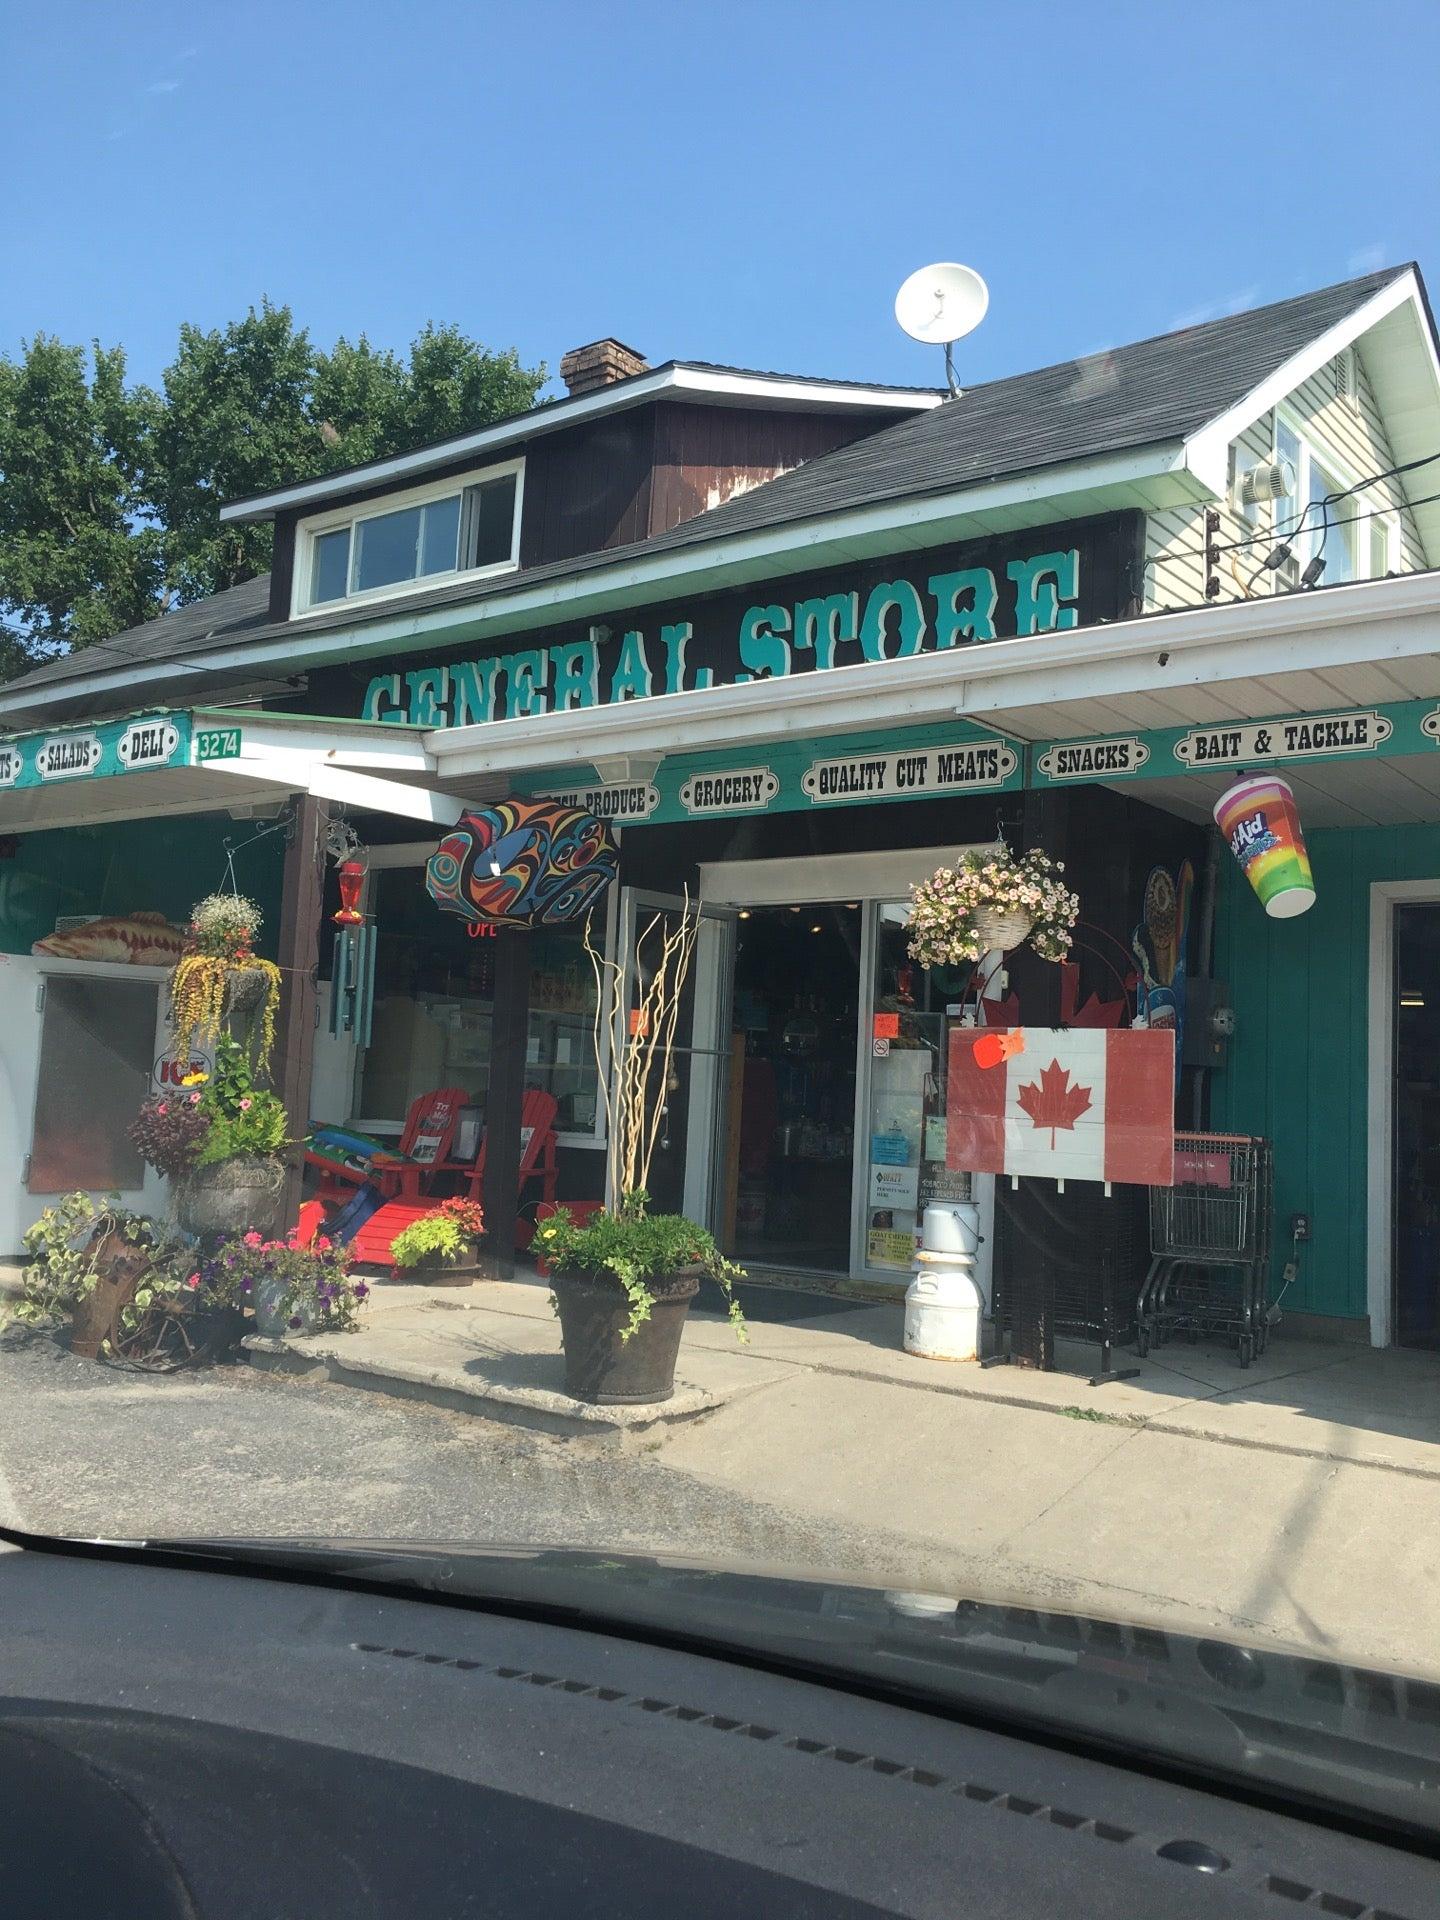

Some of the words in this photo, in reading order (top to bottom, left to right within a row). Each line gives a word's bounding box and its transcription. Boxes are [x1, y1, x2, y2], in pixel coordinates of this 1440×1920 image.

[361, 622, 713, 727] GENERAL
[735, 549, 1079, 683] STORE
[130, 728, 164, 760] DELI
[201, 732, 237, 758] 3274
[1194, 731, 1242, 760] BAIT
[1254, 729, 1272, 754] &
[1284, 718, 1368, 751] TACKLE
[47, 740, 90, 771] SALADS
[1056, 744, 1130, 774] SNACKS
[819, 760, 887, 795] QUALITY
[896, 756, 927, 788] CUT
[937, 749, 998, 784] MEATS
[586, 787, 645, 819] PRODUCE
[694, 775, 764, 807] GROCERY
